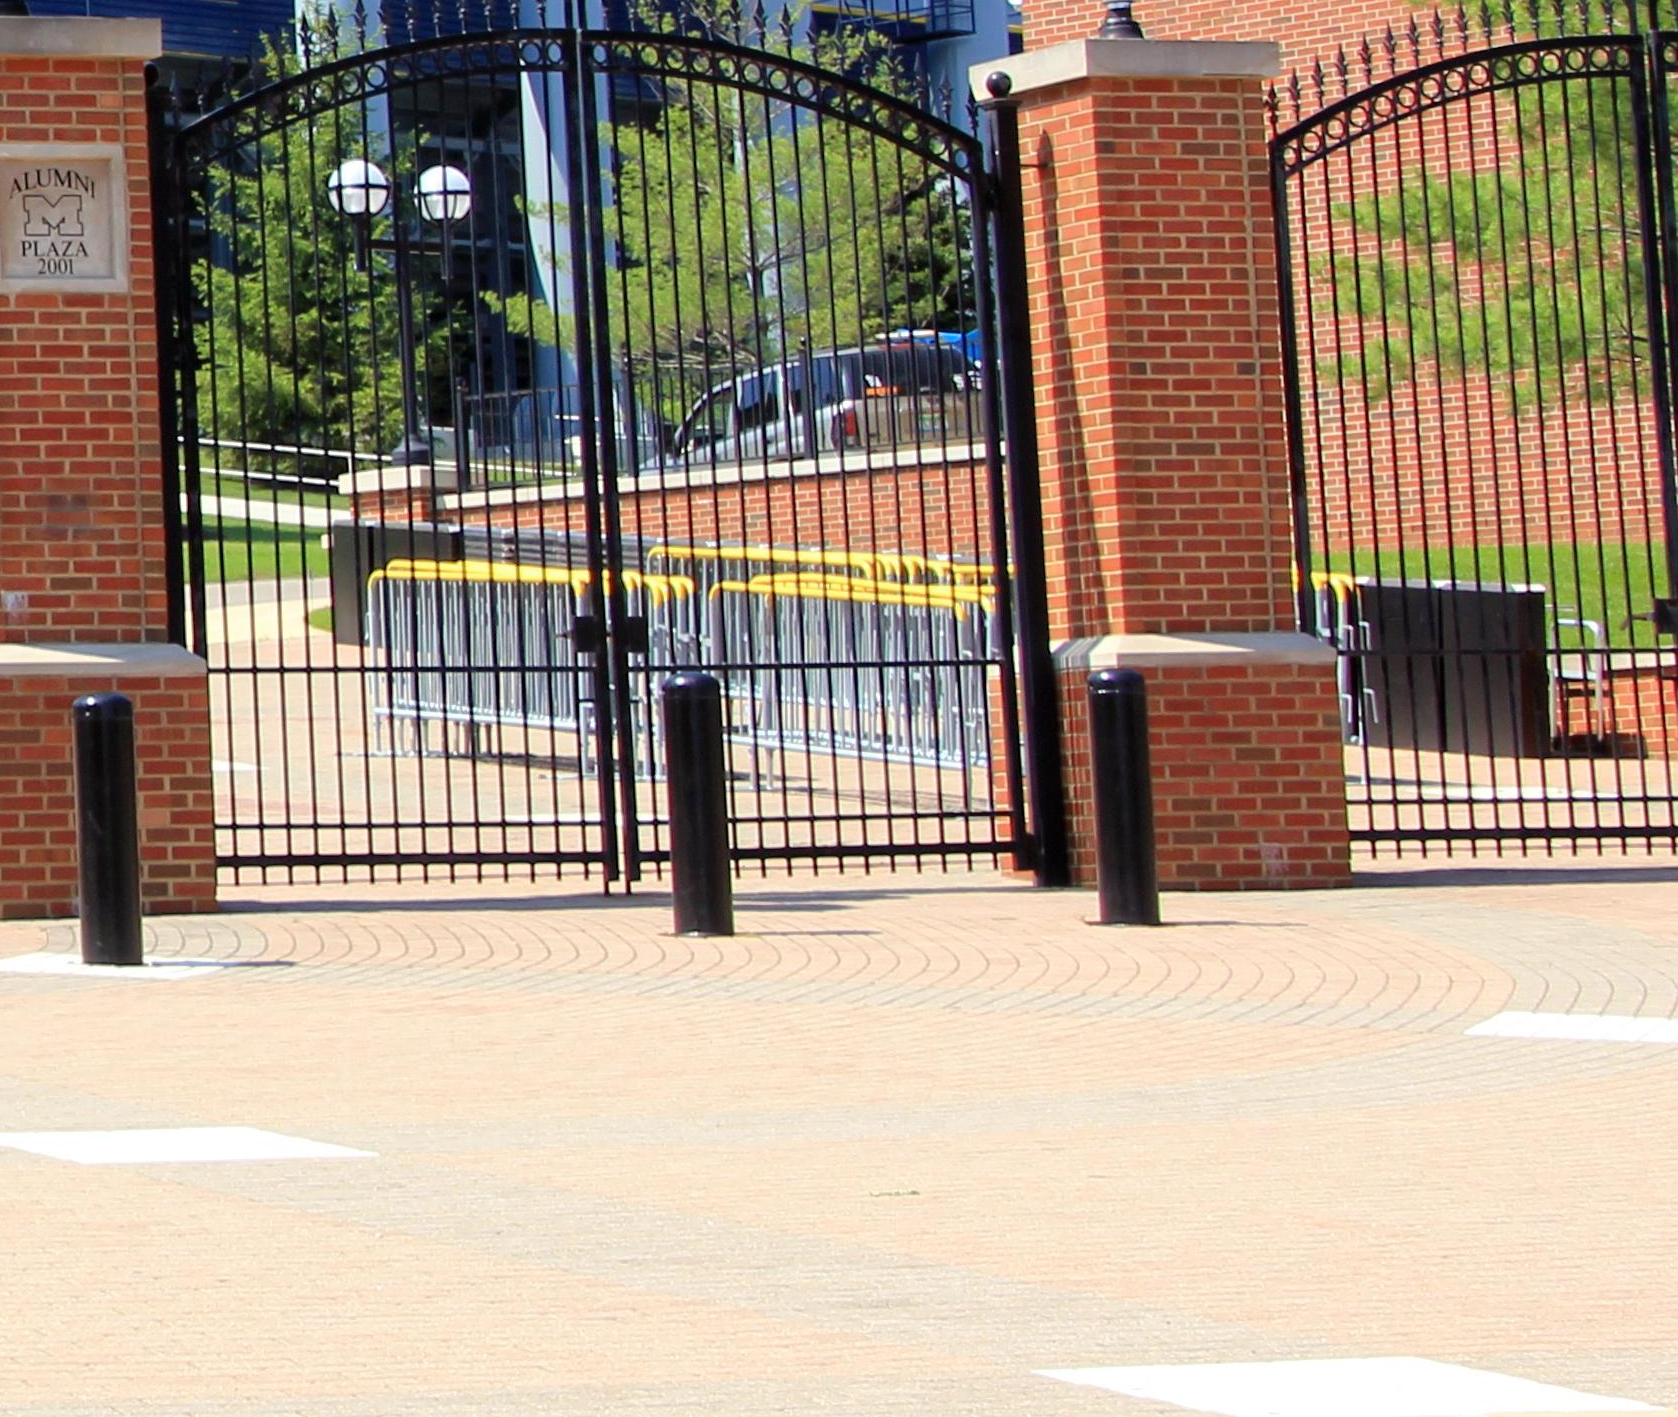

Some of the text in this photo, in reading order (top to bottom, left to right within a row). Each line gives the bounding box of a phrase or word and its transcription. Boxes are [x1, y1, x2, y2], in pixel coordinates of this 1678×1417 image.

[9, 166, 97, 201] ALUMNI
[22, 194, 85, 238] M
[20, 240, 90, 259] PLAZA
[38, 258, 75, 276] 2001
